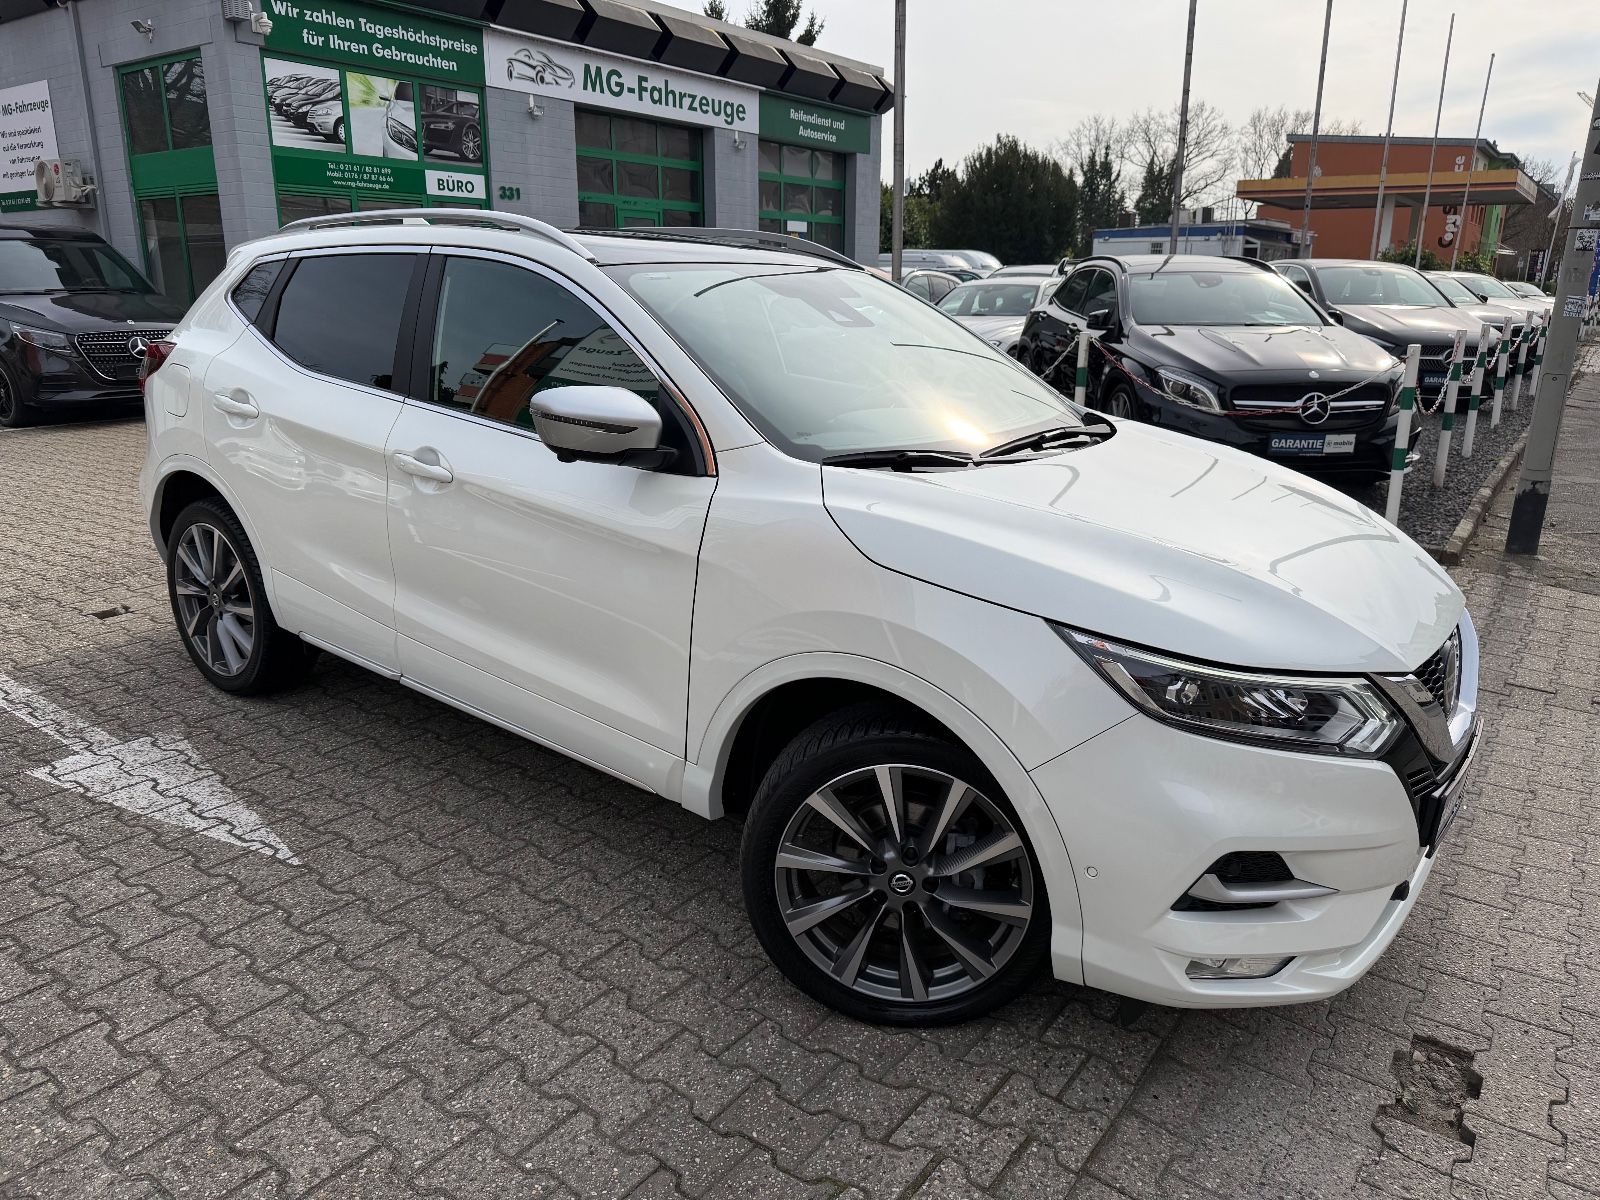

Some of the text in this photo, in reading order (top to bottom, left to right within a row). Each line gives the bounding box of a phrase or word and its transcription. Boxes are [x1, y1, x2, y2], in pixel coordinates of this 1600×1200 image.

[271, 0, 478, 55] Wir zahlen Tageshöchstpreise
[302, 29, 458, 72] für Ihren Gebrauchten
[582, 62, 748, 126] MG-Fahrzeuge
[1, 99, 49, 116] MG-Fahrzeuge
[789, 107, 845, 131] Reifendienst und
[798, 123, 837, 143] Autoservice
[326, 170, 344, 178] Mobil:
[437, 174, 475, 194] BÜRO
[498, 185, 522, 201] 331
[1271, 438, 1325, 449] GARANTIE
